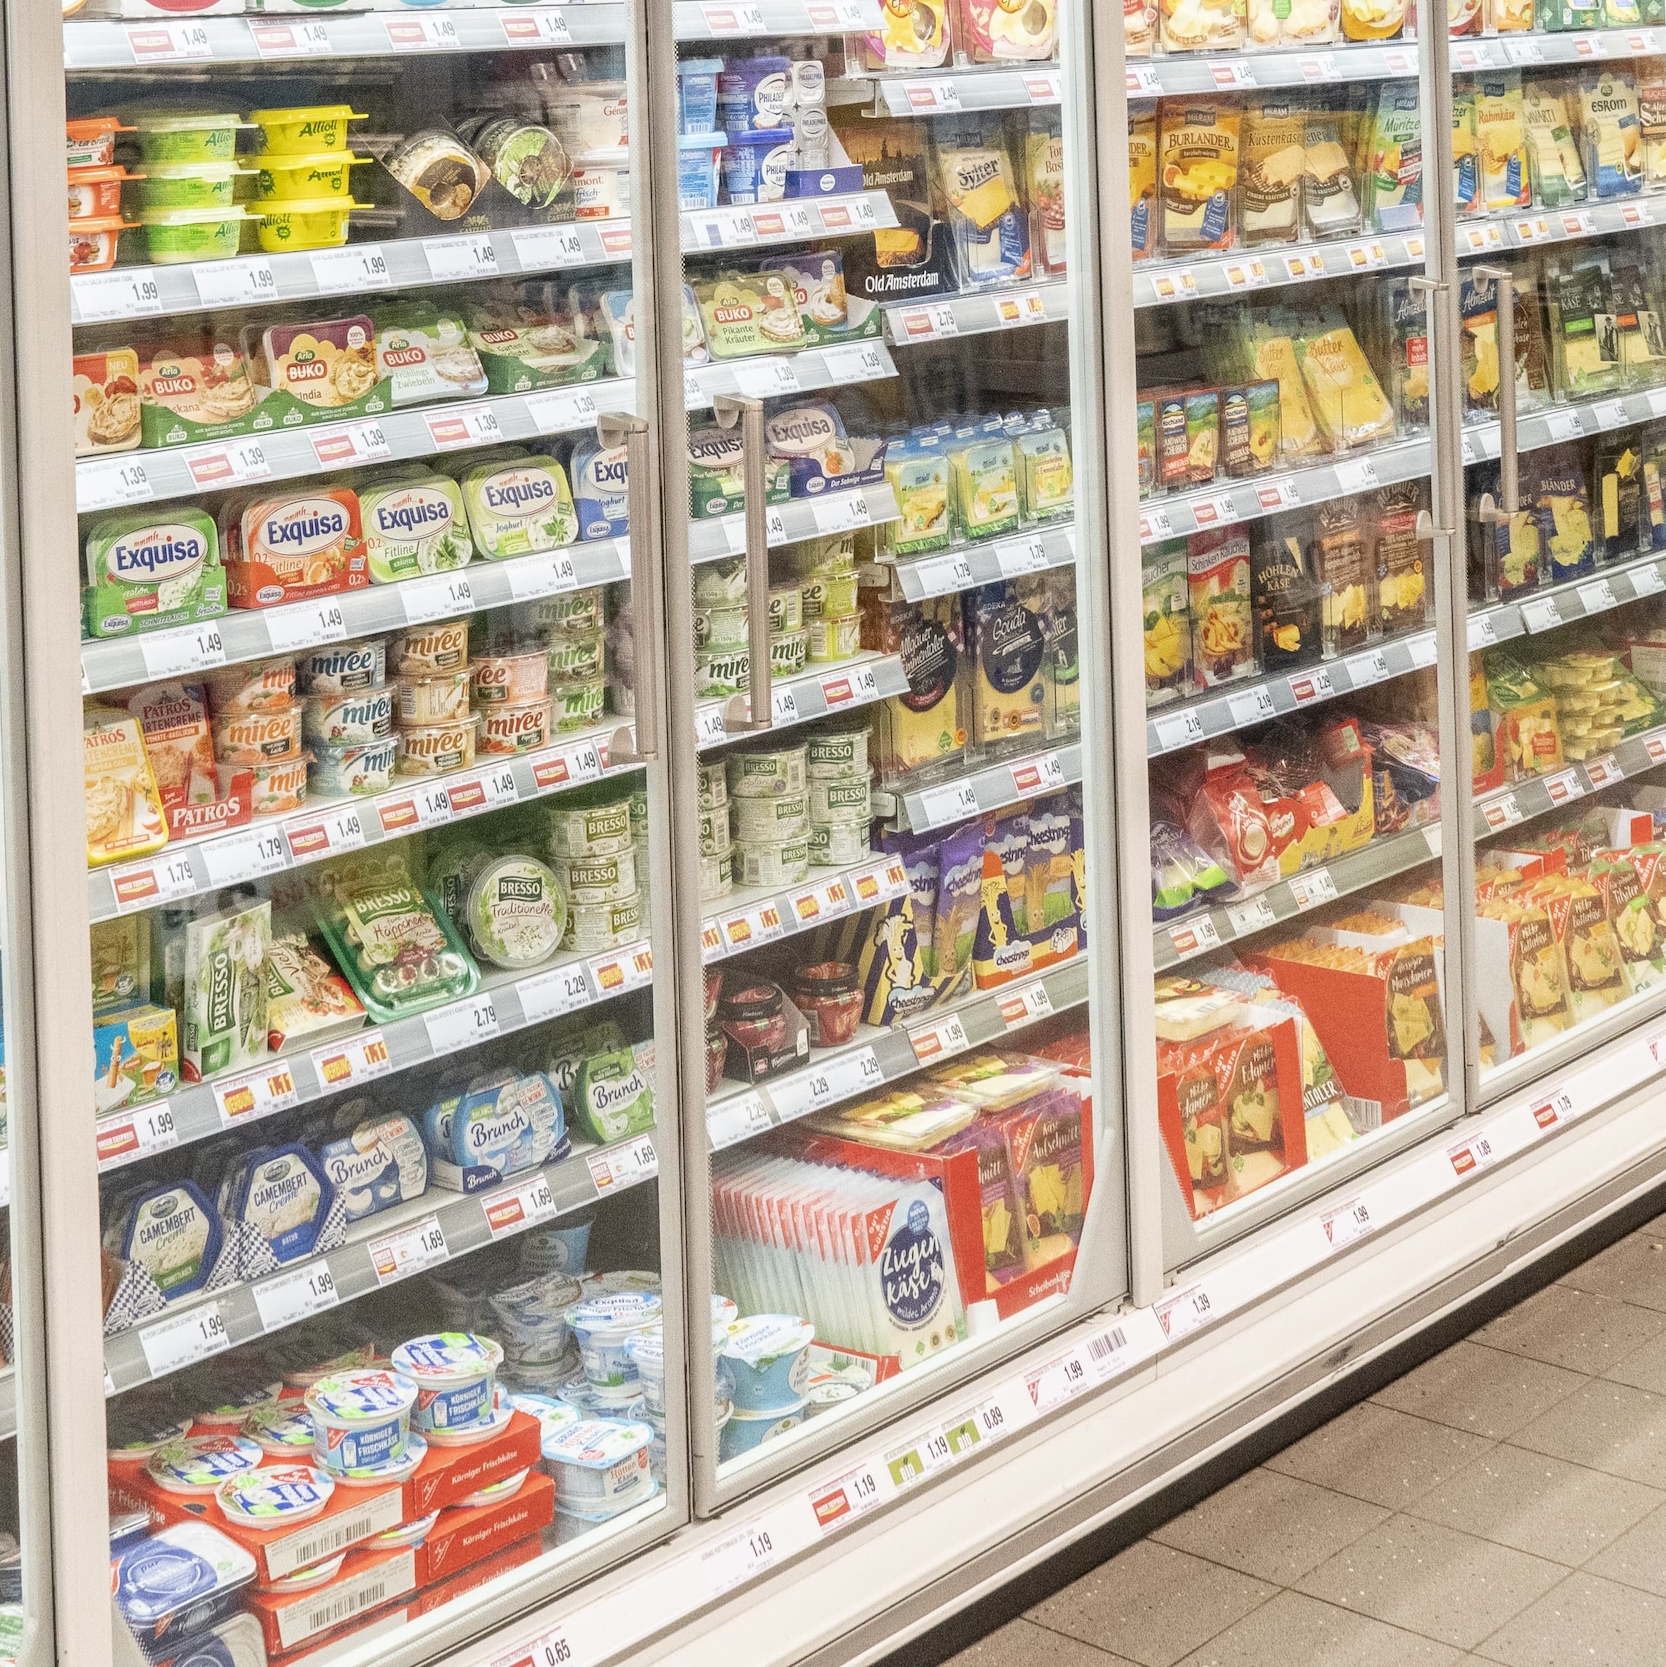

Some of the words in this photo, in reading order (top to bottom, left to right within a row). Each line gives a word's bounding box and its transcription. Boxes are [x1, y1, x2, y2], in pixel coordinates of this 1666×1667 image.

[742, 9, 762, 25] 1.49
[842, 5, 860, 20] 1.49
[432, 21, 456, 38] 1.49
[545, 17, 569, 33] 1.49
[182, 29, 208, 46] 1.49
[1591, 99, 1628, 114] ESROM
[1478, 110, 1517, 124] Rahmkäse
[1169, 134, 1232, 150] BURLANDER
[473, 244, 495, 263] 1.49
[362, 256, 387, 276] 1.99
[865, 274, 884, 293] Old
[885, 270, 939, 291] Amsterdam
[131, 281, 158, 302] 1.99
[716, 308, 751, 321] BUKO
[384, 349, 424, 365] BUKO
[1307, 338, 1345, 359] Butter
[288, 362, 325, 379] BUKO
[154, 379, 194, 394] BUKO
[769, 416, 832, 447] Exquisa
[484, 477, 556, 511] Exquisa
[377, 497, 450, 531] Exquisa
[266, 509, 343, 545] Exquisa
[116, 535, 201, 572] Exquisa
[1259, 565, 1299, 582] HÖHLEN
[1185, 716, 1202, 733] 2.19
[811, 742, 853, 761] BRESSO
[744, 760, 778, 775] BRESSO
[829, 784, 866, 804] BRESSO
[172, 797, 242, 830] PATROS
[587, 814, 627, 836] BRESSO
[570, 866, 617, 884] BRESSO
[498, 879, 542, 897] BRESSO
[945, 1025, 964, 1042] 1.99
[860, 1058, 879, 1077] 2.29
[810, 1078, 830, 1096] 2.29
[471, 1113, 526, 1148] Brunch
[253, 1173, 309, 1206] CAMEMBERT
[1352, 1205, 1369, 1223] 1.99
[139, 1205, 196, 1245] CAMEMBERT
[421, 1231, 445, 1252] 1.69
[883, 1234, 941, 1277] Ziegen
[308, 1272, 334, 1296] 1.99
[886, 1269, 931, 1305] käse
[1191, 1295, 1211, 1313] 1.39
[983, 1407, 1004, 1429] 0.89
[451, 1465, 482, 1485] Körniger
[482, 1449, 518, 1471] Frischkäse
[463, 1526, 493, 1546] Körniger
[493, 1510, 529, 1532] Frischkäse
[545, 1639, 571, 1665] 0.65
